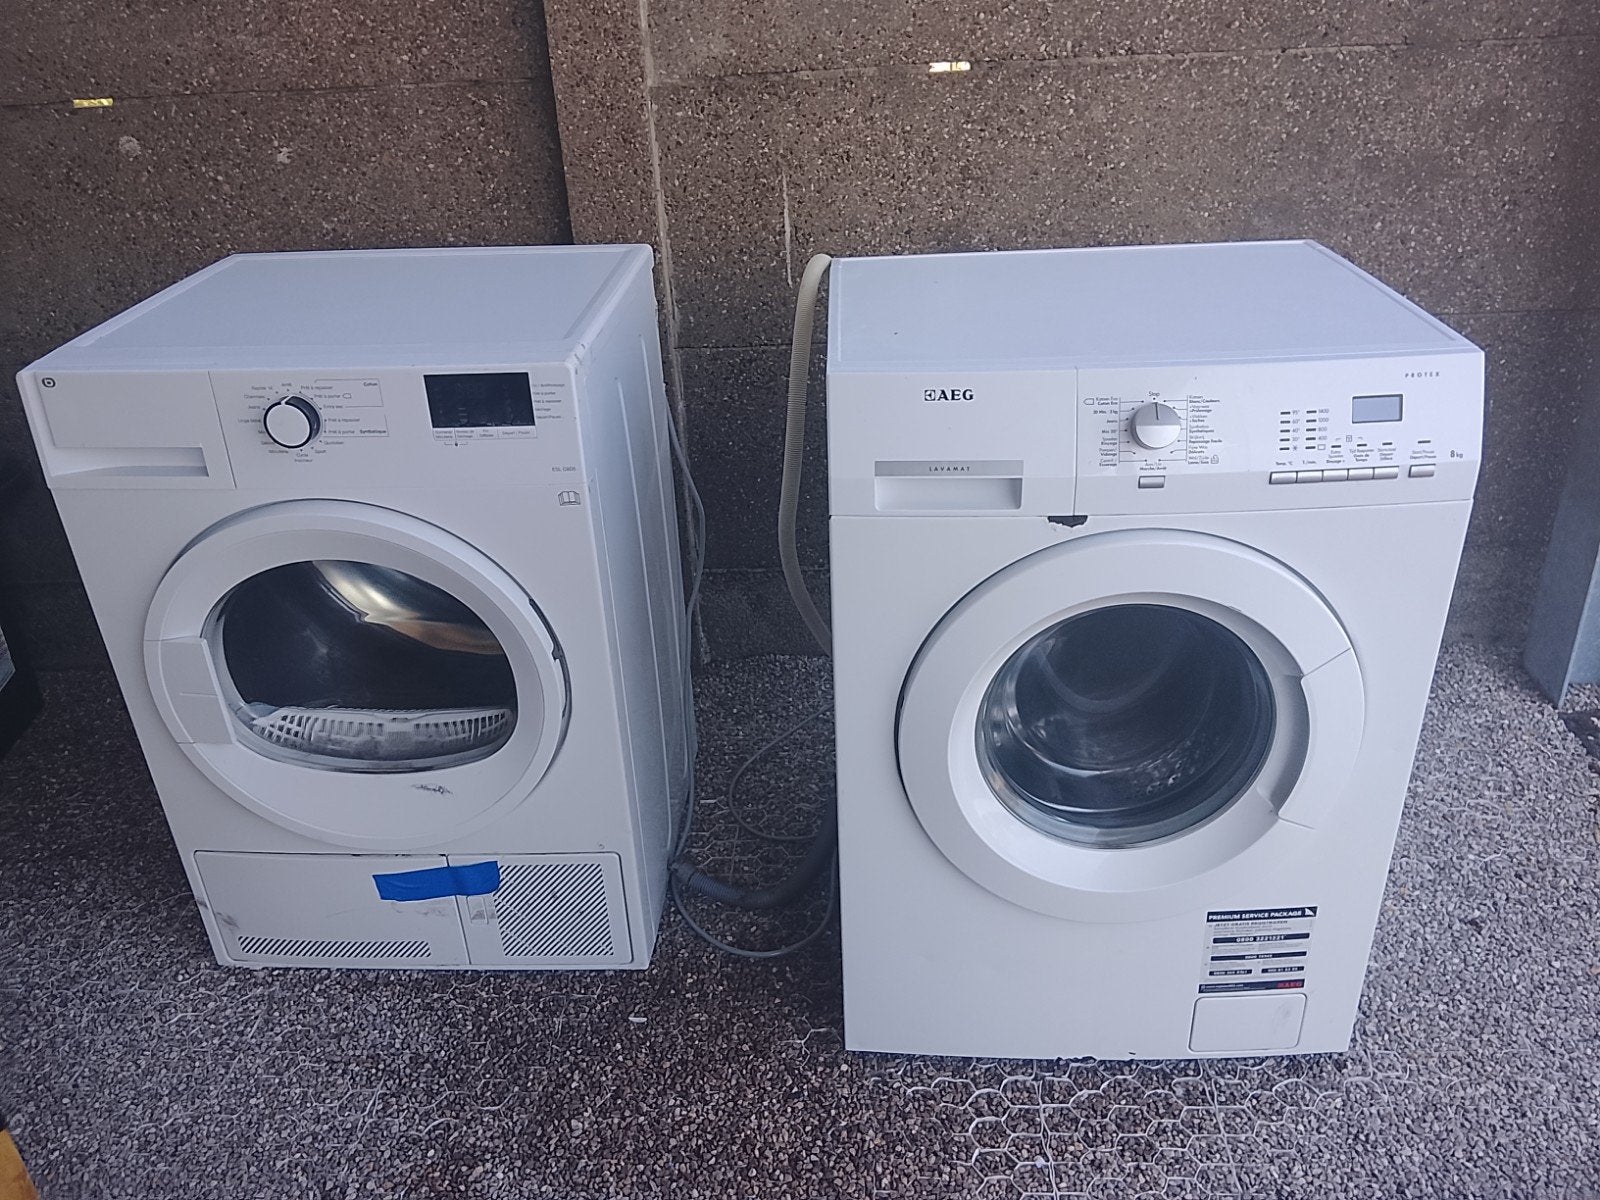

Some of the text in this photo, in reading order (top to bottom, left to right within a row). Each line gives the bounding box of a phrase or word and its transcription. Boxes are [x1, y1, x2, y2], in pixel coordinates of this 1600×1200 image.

[937, 389, 974, 401] AEG
[1450, 449, 1456, 458] 8
[1208, 910, 1302, 921] PREMIUM SERVICE PACKAGE
